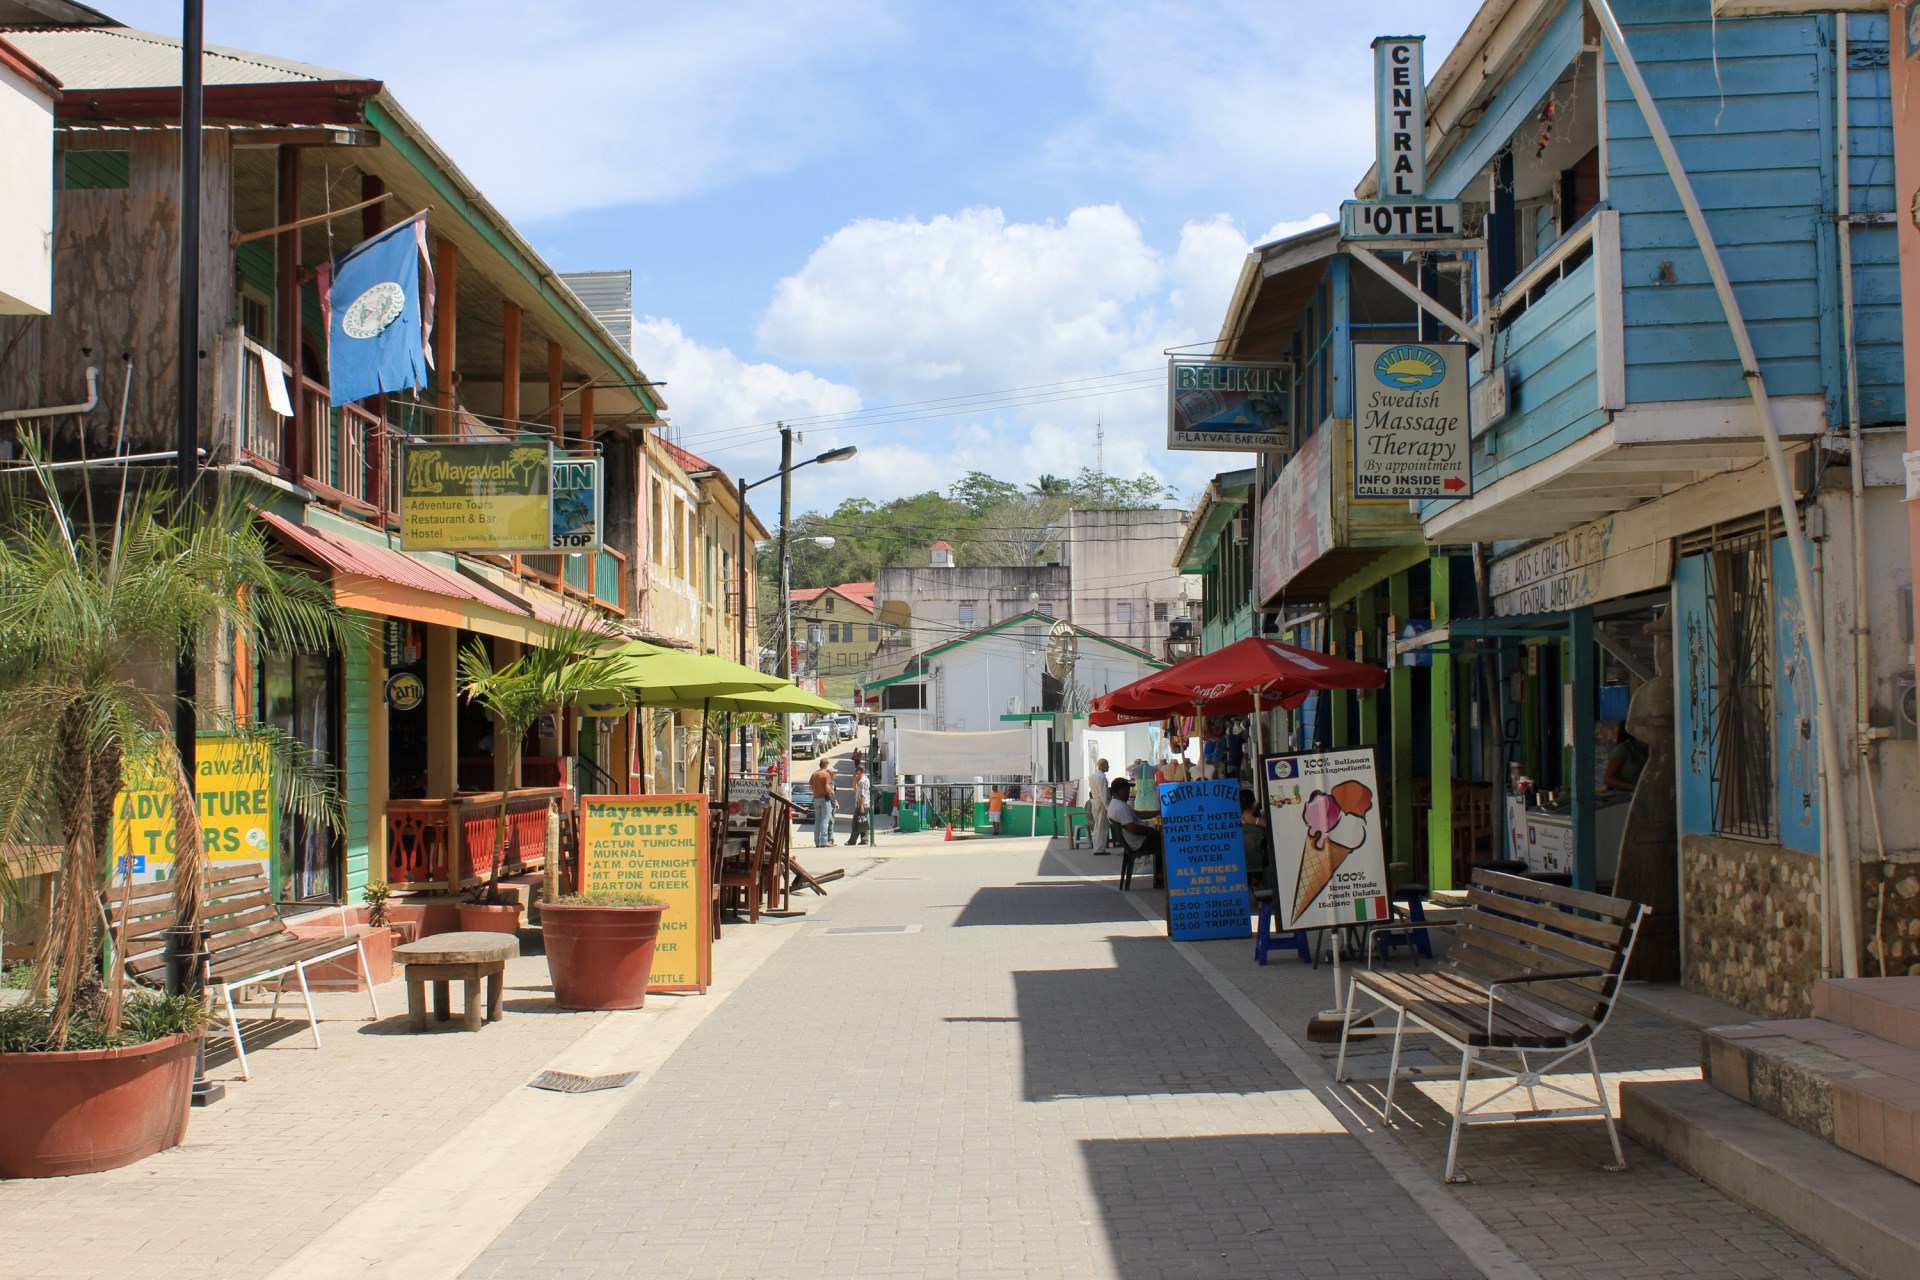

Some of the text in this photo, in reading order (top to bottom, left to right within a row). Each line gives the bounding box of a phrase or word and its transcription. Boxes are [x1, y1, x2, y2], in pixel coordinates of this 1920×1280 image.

[1391, 45, 1413, 195] CENTRAL
[1176, 366, 1288, 393] BELIKIN
[1368, 390, 1440, 408] Swedish
[1364, 410, 1458, 437] Massage
[1235, 434, 1253, 444] BAR
[1258, 436, 1285, 446] GRILL
[1368, 433, 1456, 462] Therapy
[435, 461, 515, 484] Mayawalk
[1364, 459, 1462, 474] By appointment
[1359, 475, 1441, 485] INFO INSIDE
[1359, 486, 1440, 495] CALL: 824 3734
[411, 499, 493, 511] Adventure Tours
[411, 513, 497, 525] Restaurant & Bar
[411, 529, 443, 539] Hostel
[468, 534, 486, 542] family
[553, 535, 591, 547] STOP
[1514, 553, 1532, 584] ARTS
[1541, 538, 1570, 576] CRAFTS
[1574, 533, 1583, 563] OF
[1520, 581, 1547, 615] CENTRAL
[390, 621, 398, 665] BELIKIN
[1192, 683, 1234, 699] Coca-Co
[1303, 756, 1331, 768] 100%
[1325, 763, 1372, 774] Ingredients
[1161, 784, 1209, 807] CENTRAL
[119, 789, 268, 820] ADVTURE
[1197, 804, 1205, 812] A
[588, 802, 699, 821] Mayawalk
[1163, 811, 1241, 824] BUDGET HOTEL
[610, 821, 678, 837] Tours
[1163, 821, 1242, 834] THAT IS CLEAN
[144, 826, 241, 854] TORS
[1170, 832, 1237, 843] AND SECURE
[594, 839, 696, 849] ACTUN TUNICHIL
[593, 850, 645, 859] MUKNAL
[1188, 854, 1223, 863] WATER
[628, 859, 698, 868] OVERNIGHT
[617, 870, 644, 879] PINE
[651, 870, 687, 879] RIDGE
[1176, 864, 1239, 876] ALL PRICES
[1190, 875, 1226, 885] ARE IN
[1336, 871, 1366, 882] 100%
[592, 880, 689, 891] BARTON CREEK
[1169, 884, 1248, 897] BELIZE DOLLARS
[1205, 899, 1243, 909] SINGLE
[1318, 899, 1351, 909] Italiano
[1204, 917, 1249, 929] TRIPPLE
